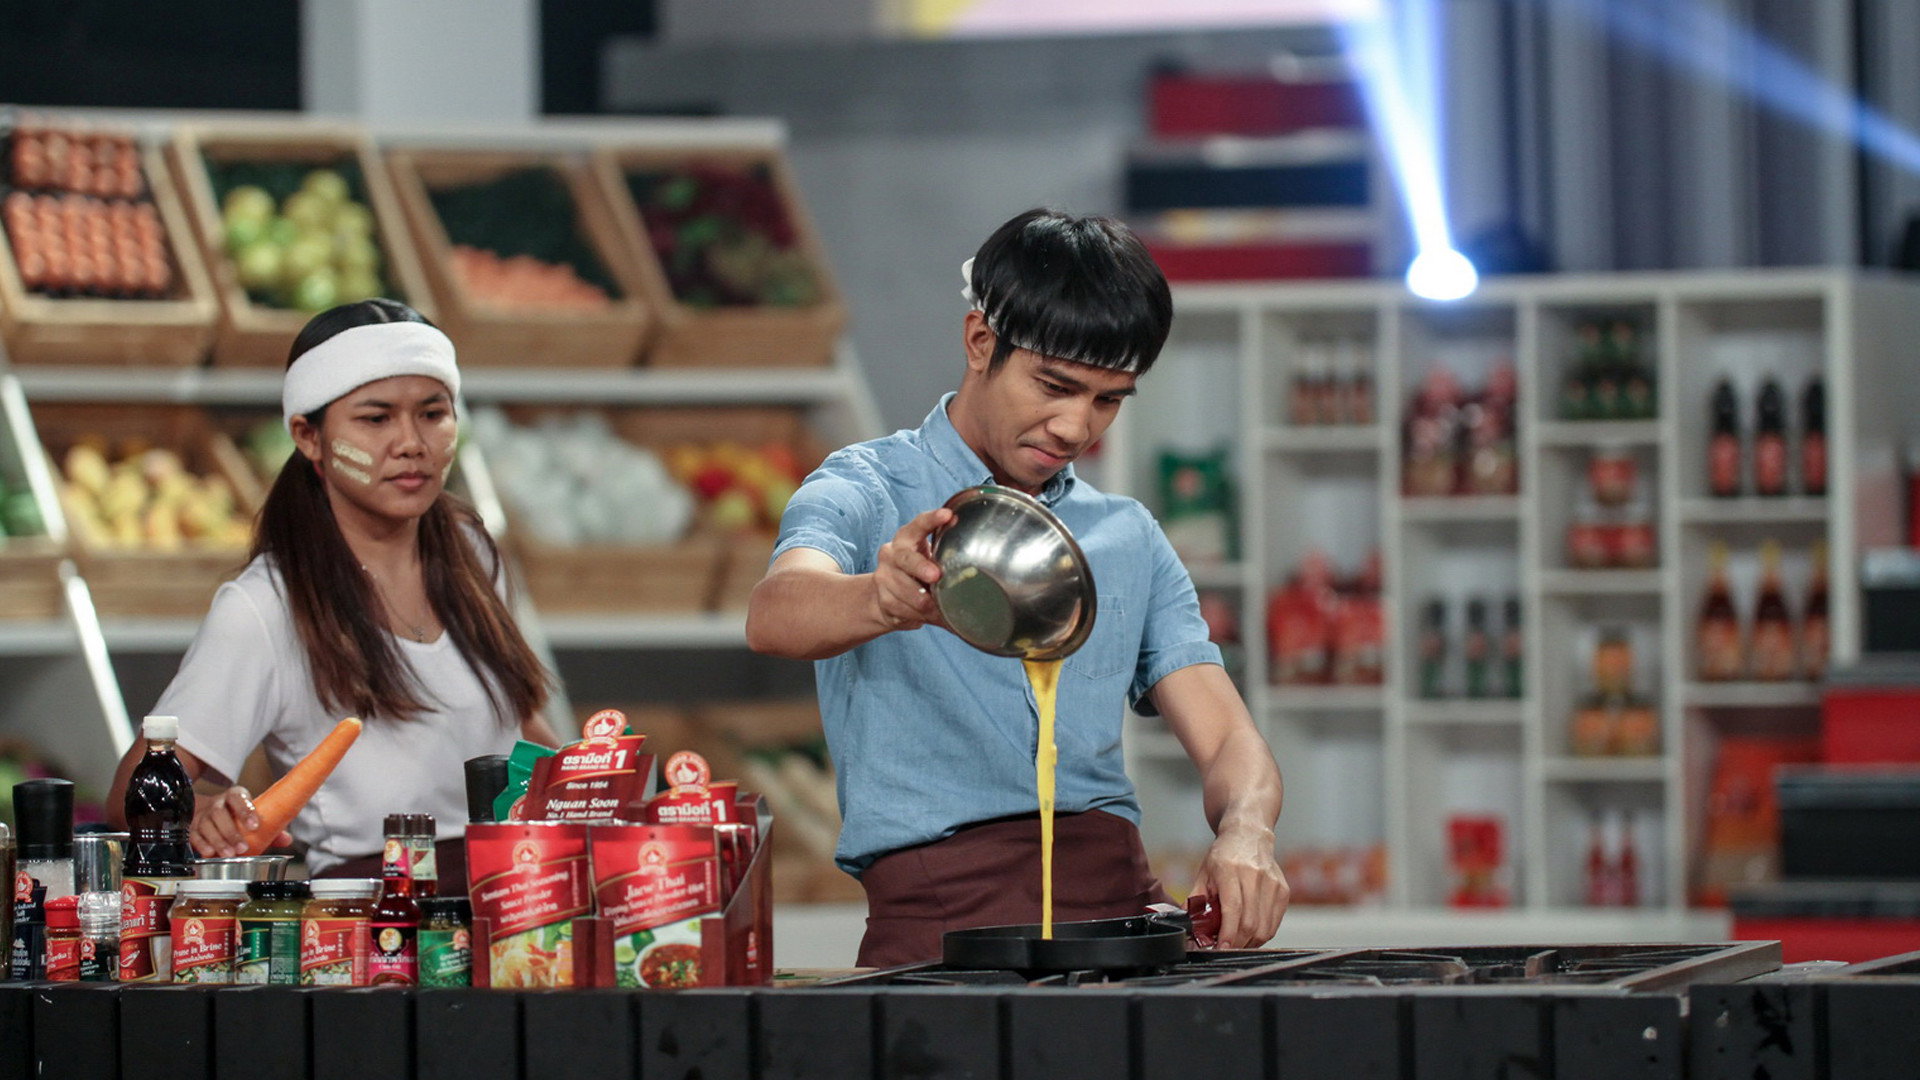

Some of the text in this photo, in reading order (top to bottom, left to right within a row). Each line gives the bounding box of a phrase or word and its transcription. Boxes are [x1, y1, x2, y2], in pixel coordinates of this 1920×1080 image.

[615, 749, 628, 769] 1
[566, 781, 588, 789] Since
[545, 798, 619, 811] Nguan Soon
[712, 799, 727, 822] 1
[588, 810, 614, 818] Brand
[658, 872, 686, 891] Thai
[501, 898, 523, 910] Sauce
[200, 943, 223, 953] Brine
